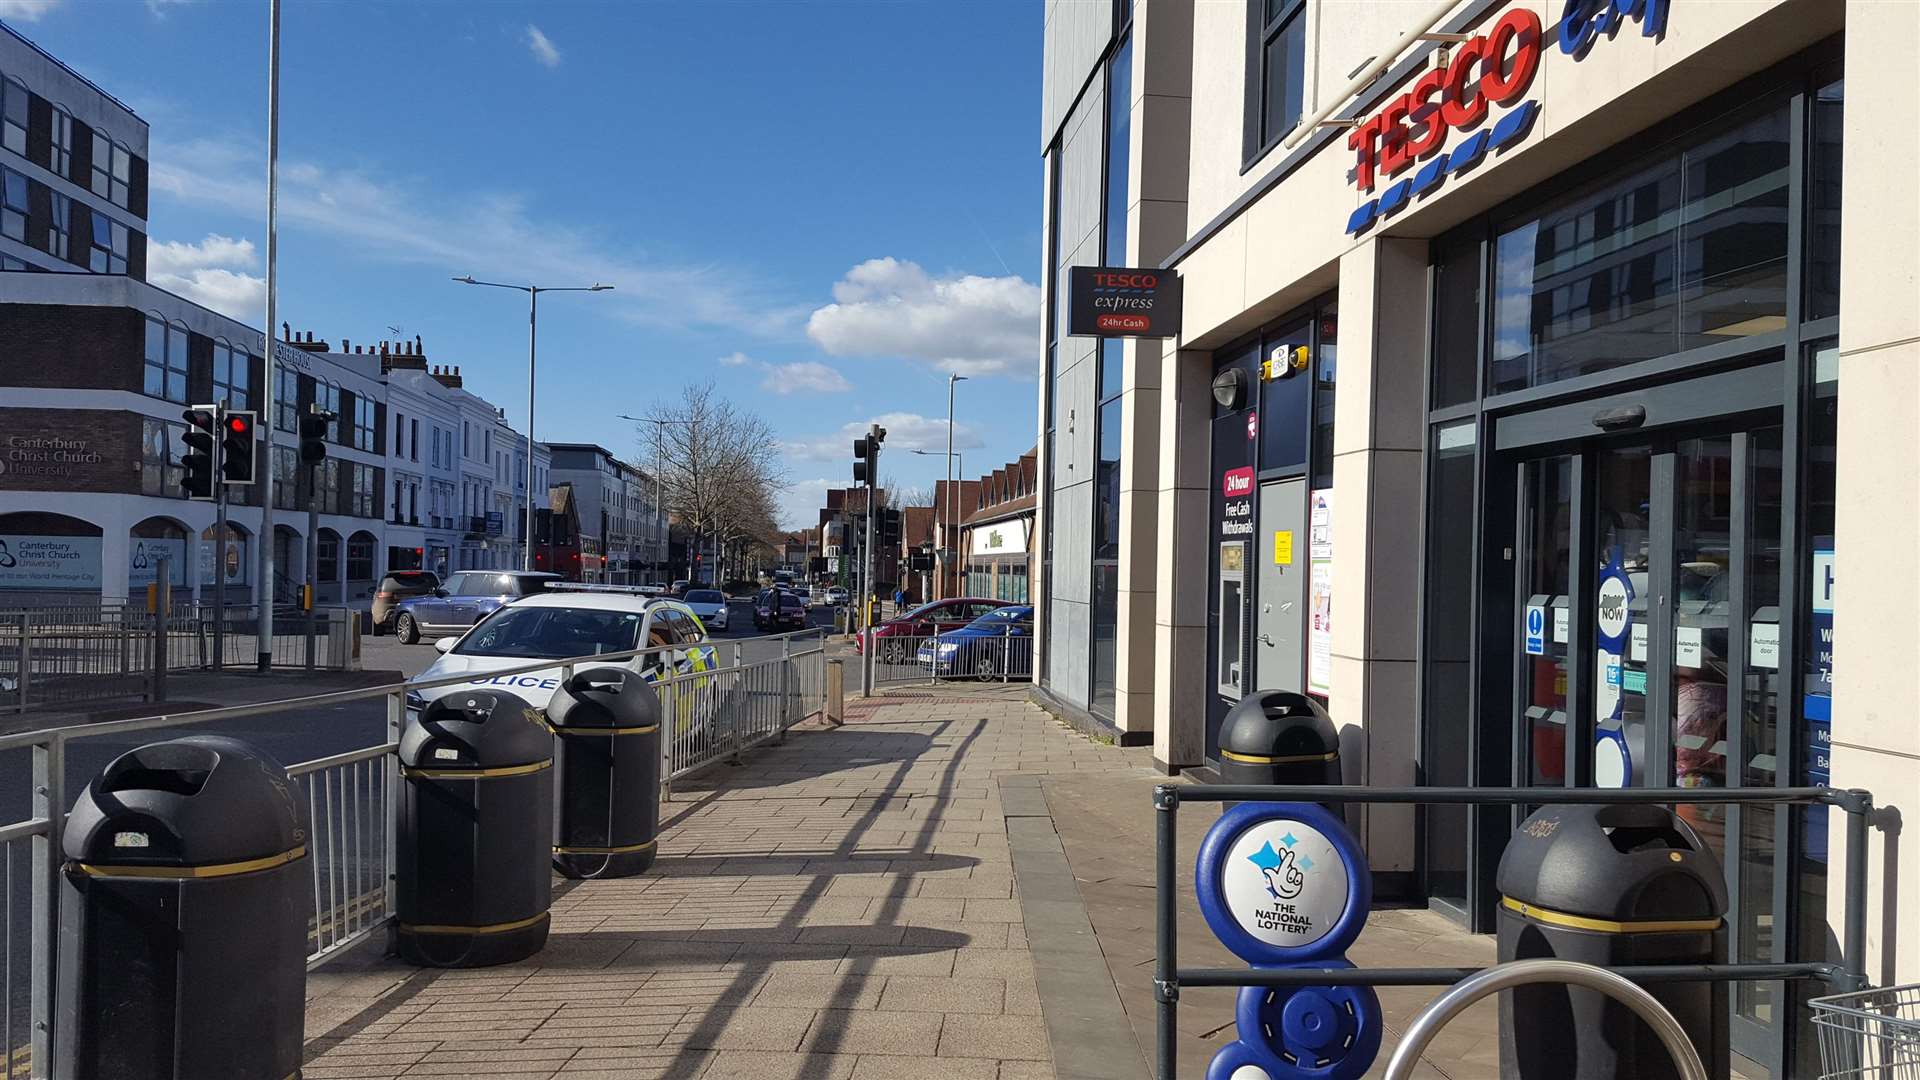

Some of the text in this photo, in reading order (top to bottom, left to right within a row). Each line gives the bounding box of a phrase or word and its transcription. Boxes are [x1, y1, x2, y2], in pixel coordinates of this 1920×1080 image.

[1348, 8, 1541, 191] TESCO
[1093, 274, 1158, 288] TESCO
[1095, 296, 1154, 311] express
[1102, 318, 1144, 328] 24hr Cash
[9, 436, 87, 453] Canterbury
[9, 449, 101, 463] Christ Church
[9, 463, 72, 479] University
[1227, 474, 1250, 491] 24 hour
[1226, 500, 1250, 517] Free Cash
[1222, 519, 1253, 535] Withdrawals
[19, 541, 71, 553] Canterbury
[19, 550, 80, 560] Christ Church
[19, 560, 61, 570] University
[1602, 607, 1624, 621] NOW
[1273, 902, 1296, 914] THE
[1255, 908, 1313, 927] NATIONAL
[1257, 919, 1308, 934] LOTTERY
